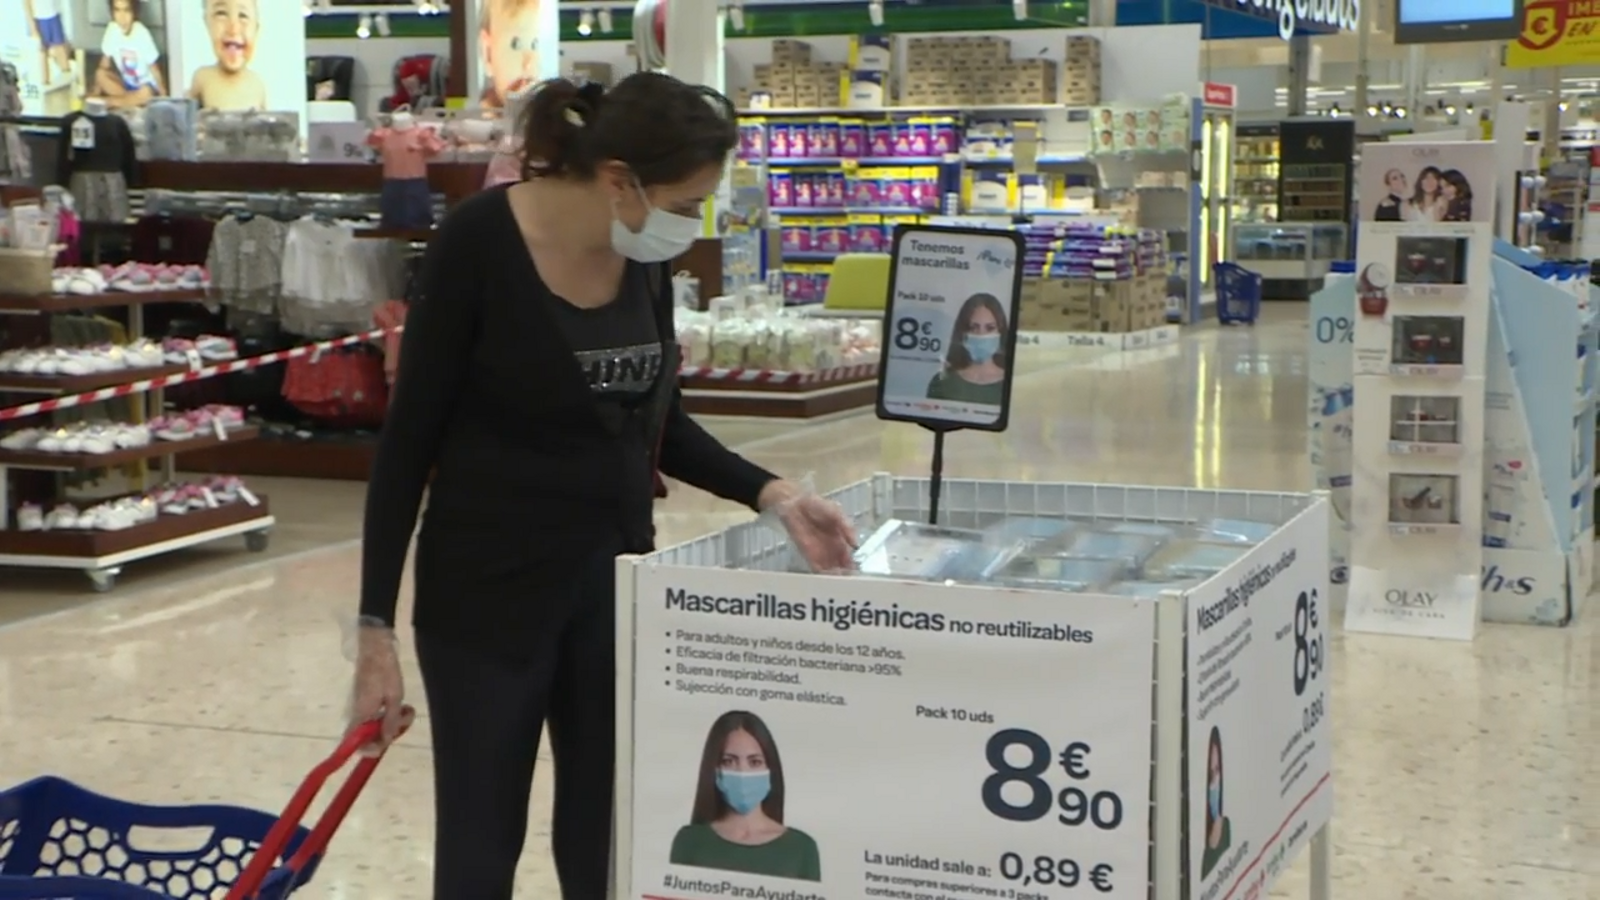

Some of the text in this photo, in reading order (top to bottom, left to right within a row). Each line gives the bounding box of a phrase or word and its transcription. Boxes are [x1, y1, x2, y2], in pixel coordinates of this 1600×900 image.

[910, 239, 965, 255] Tenemos
[901, 255, 971, 270] mascarillas
[918, 292, 929, 302] 10
[894, 317, 919, 351] 8
[920, 321, 933, 336] €
[919, 337, 942, 353] 90
[1309, 588, 1318, 629] €
[1384, 588, 1439, 608] OLAY
[665, 587, 1094, 644] Mascarillas higiénicas no reutilizables
[676, 629, 906, 660] Para adultos y niños desde los 12 años.
[1294, 591, 1309, 696] 8
[676, 646, 723, 662] Eficacia
[725, 650, 741, 663] de
[743, 651, 797, 668] filtración
[799, 656, 866, 674] bacteriana
[676, 663, 802, 685] Buena respirabilidad.
[676, 679, 848, 706] Sujección con goma elástica.
[916, 705, 994, 724] Pack 10 uds
[1058, 741, 1091, 780] €
[981, 728, 1054, 822] 8
[1058, 787, 1123, 830] 90
[864, 849, 1114, 893] La unidad sale a: 0,89 €
[663, 874, 827, 900] #JuntosParaAyudarte
[865, 871, 890, 883] Para
[891, 874, 938, 890] compras
[940, 880, 998, 898] superiores
[999, 888, 1007, 898] a
[1008, 889, 1016, 900] 3
[865, 886, 912, 900] contacta
